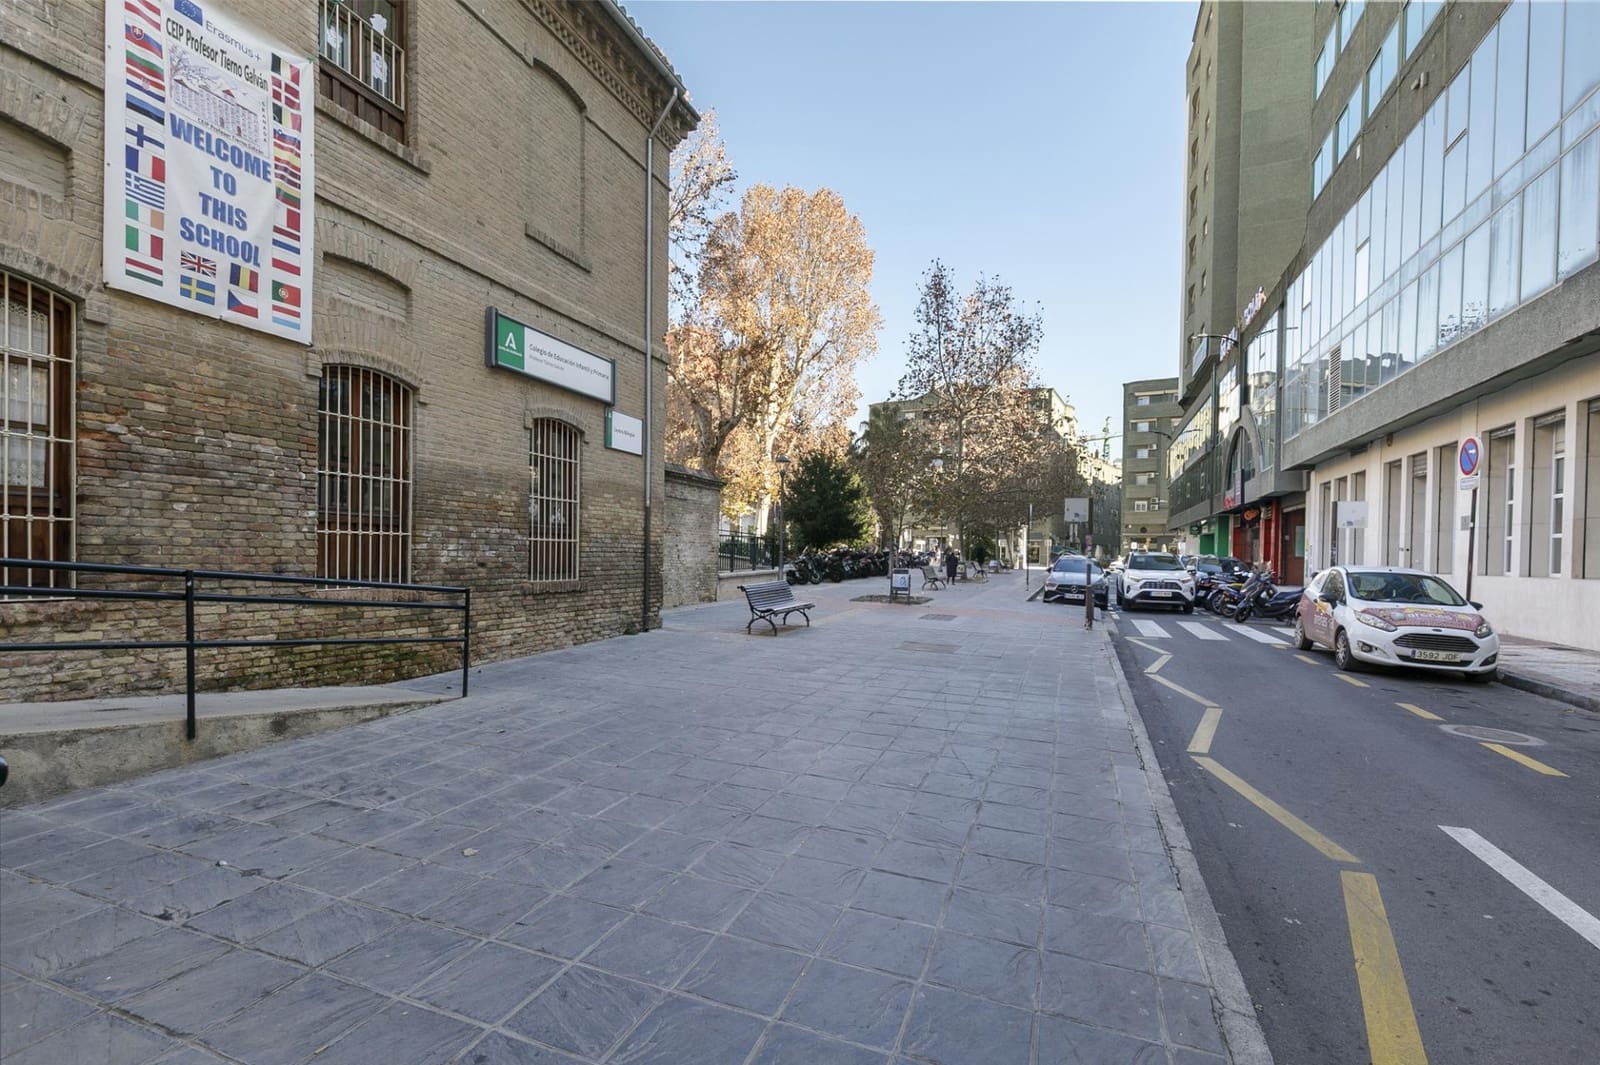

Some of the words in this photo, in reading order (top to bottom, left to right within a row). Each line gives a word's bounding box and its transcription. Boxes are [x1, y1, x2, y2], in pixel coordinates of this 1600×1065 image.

[166, 17, 184, 41] CEIP
[186, 28, 218, 63] Profesor
[220, 48, 243, 78] Tierno
[244, 64, 269, 91] Galván
[206, 20, 261, 61] Erasmus+
[169, 112, 272, 183] WELCOME
[210, 165, 237, 197] TO
[198, 191, 248, 231] THIS
[179, 216, 261, 268] SCHOOL
[529, 343, 547, 356] Colegio
[1417, 650, 1440, 660] 3592
